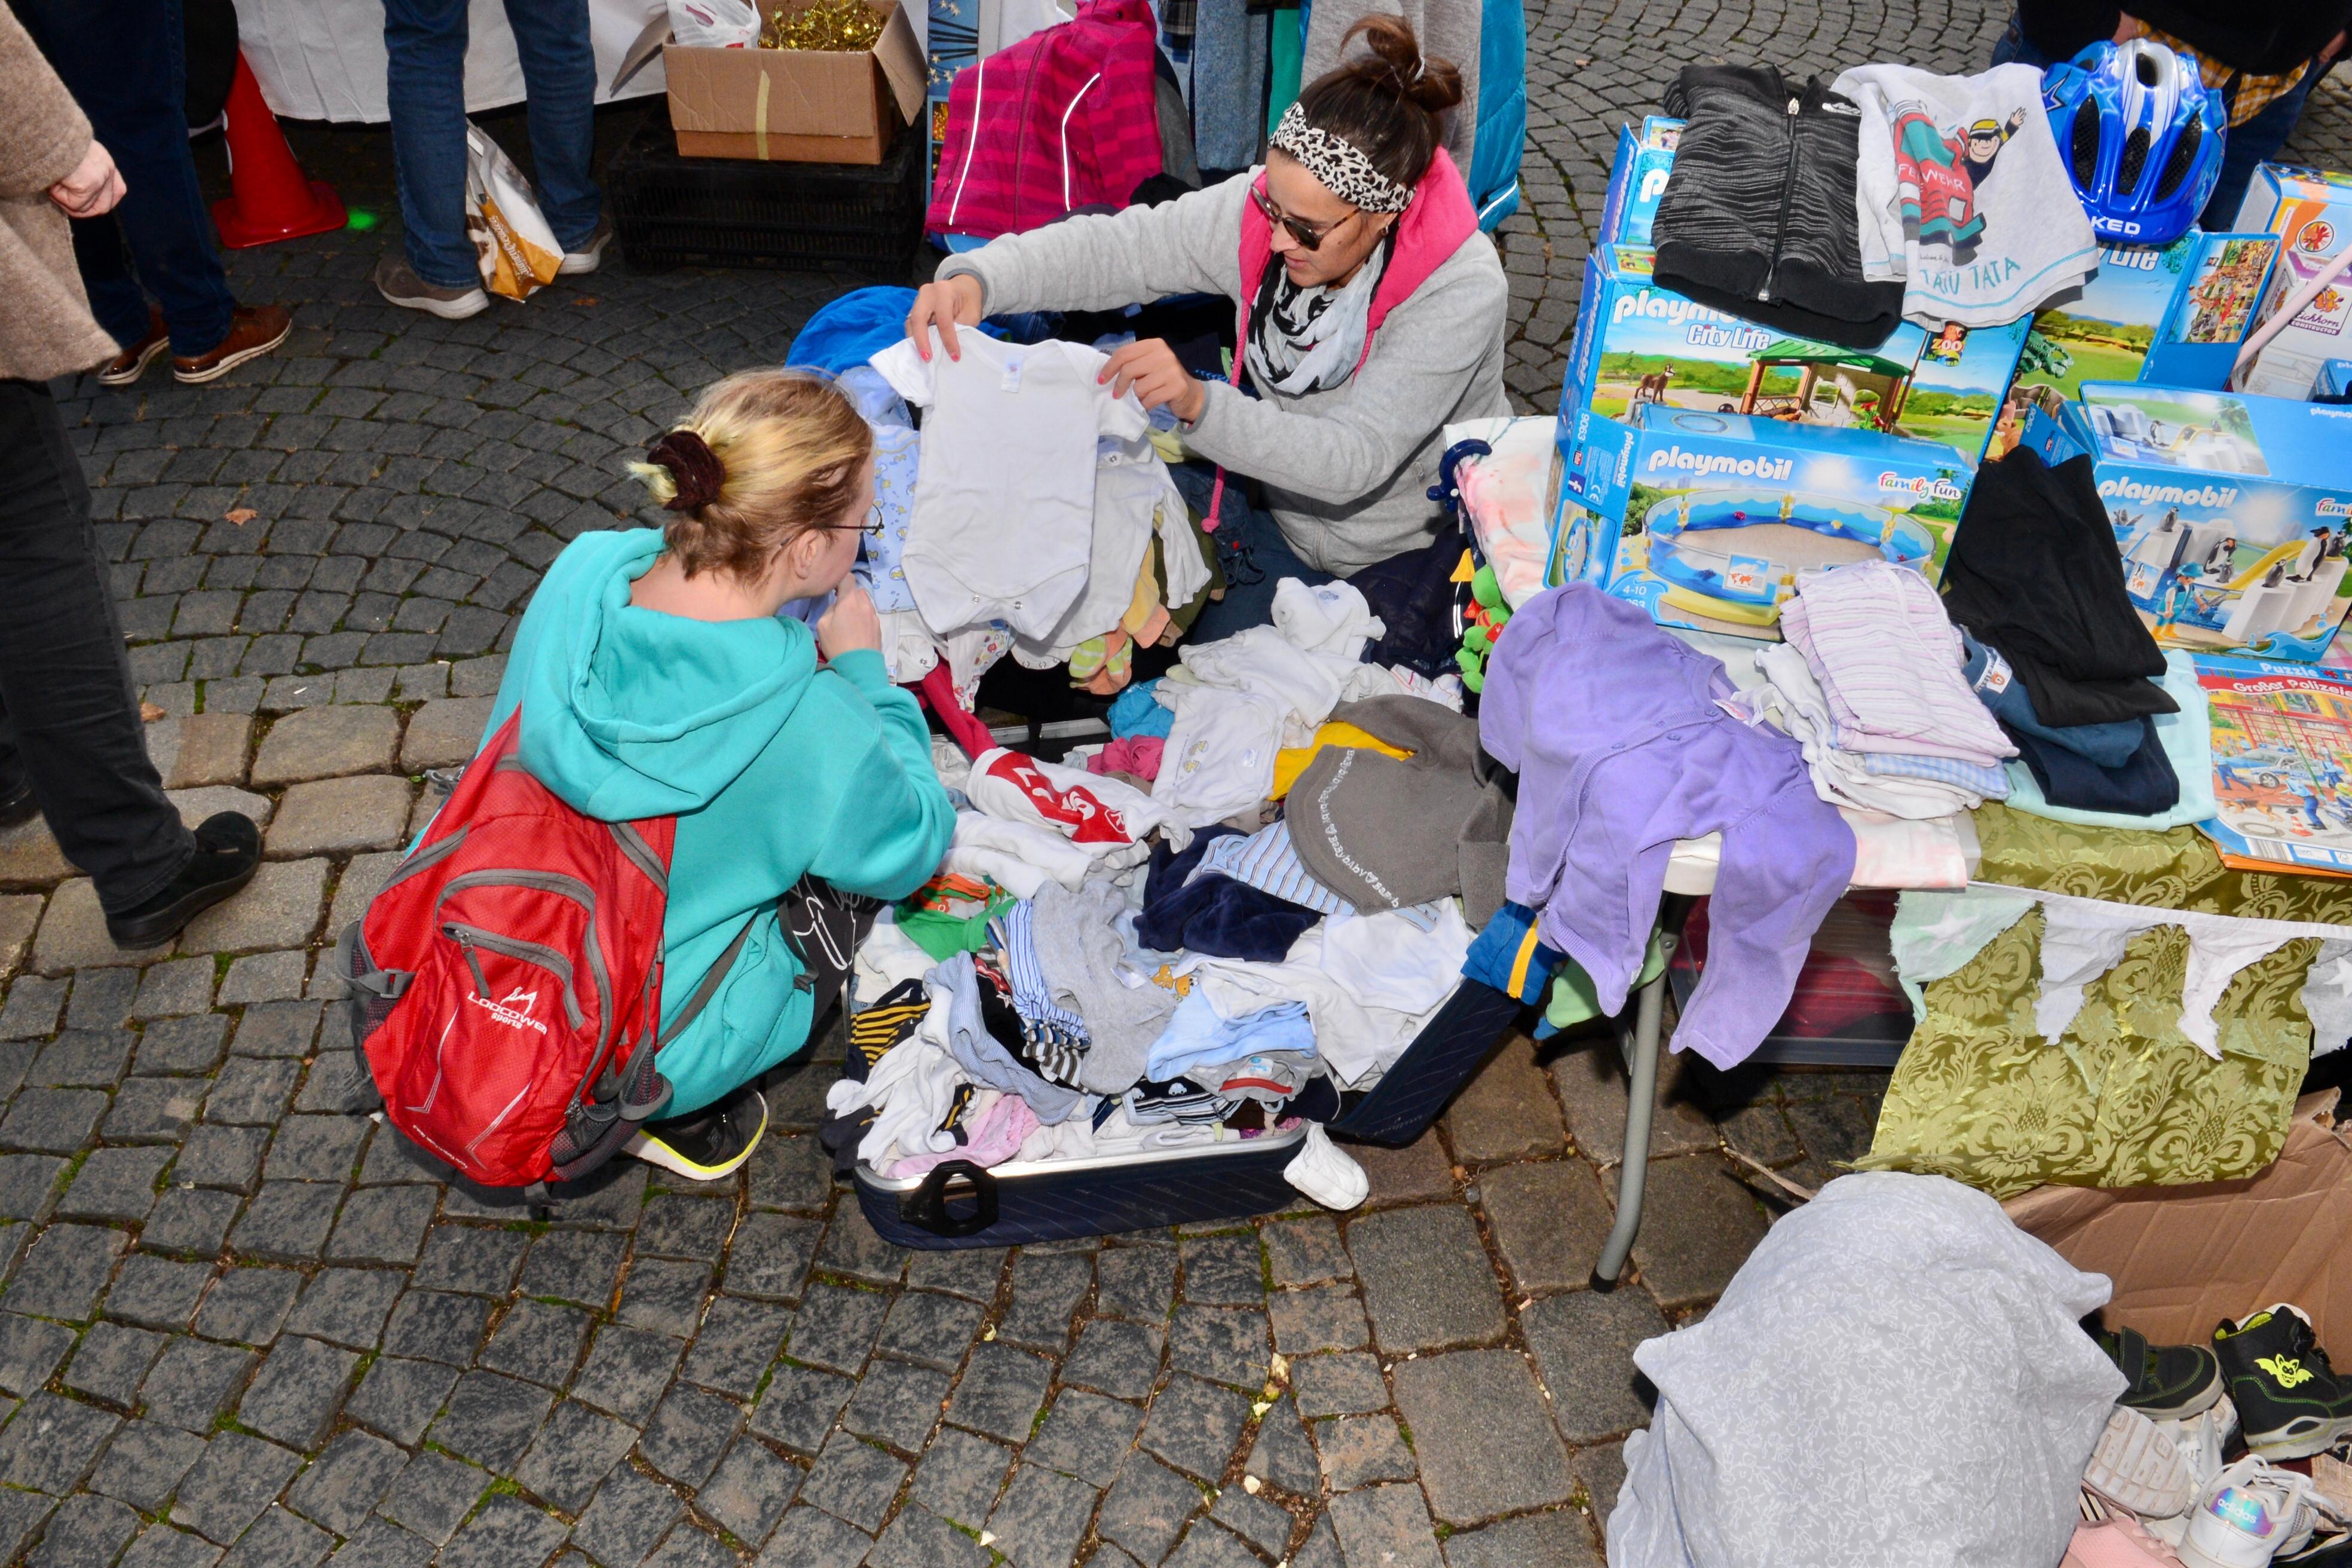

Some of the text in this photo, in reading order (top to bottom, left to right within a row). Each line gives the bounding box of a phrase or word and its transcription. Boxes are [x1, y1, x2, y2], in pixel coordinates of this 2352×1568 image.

[1610, 144, 1634, 243] playmob
[2091, 216, 2141, 235] KED
[1971, 257, 2021, 289] TATA
[1613, 290, 1750, 326] playmo
[1687, 323, 1771, 350] City Life
[2291, 320, 2337, 335] CONSTRUCTOR
[1931, 338, 1963, 351] ZOO
[2310, 407, 2352, 418] playmo
[1578, 414, 1590, 441] 9063
[1616, 431, 1635, 488] playmobil
[1647, 446, 1793, 480] playmobil
[2097, 476, 2238, 508] playmobil
[1623, 585, 1647, 595] 4-10
[2259, 662, 2319, 677] Puzzle
[2232, 681, 2284, 693] Großer
[491, 1012, 523, 1030] sports
[2218, 1498, 2257, 1524] adidas
